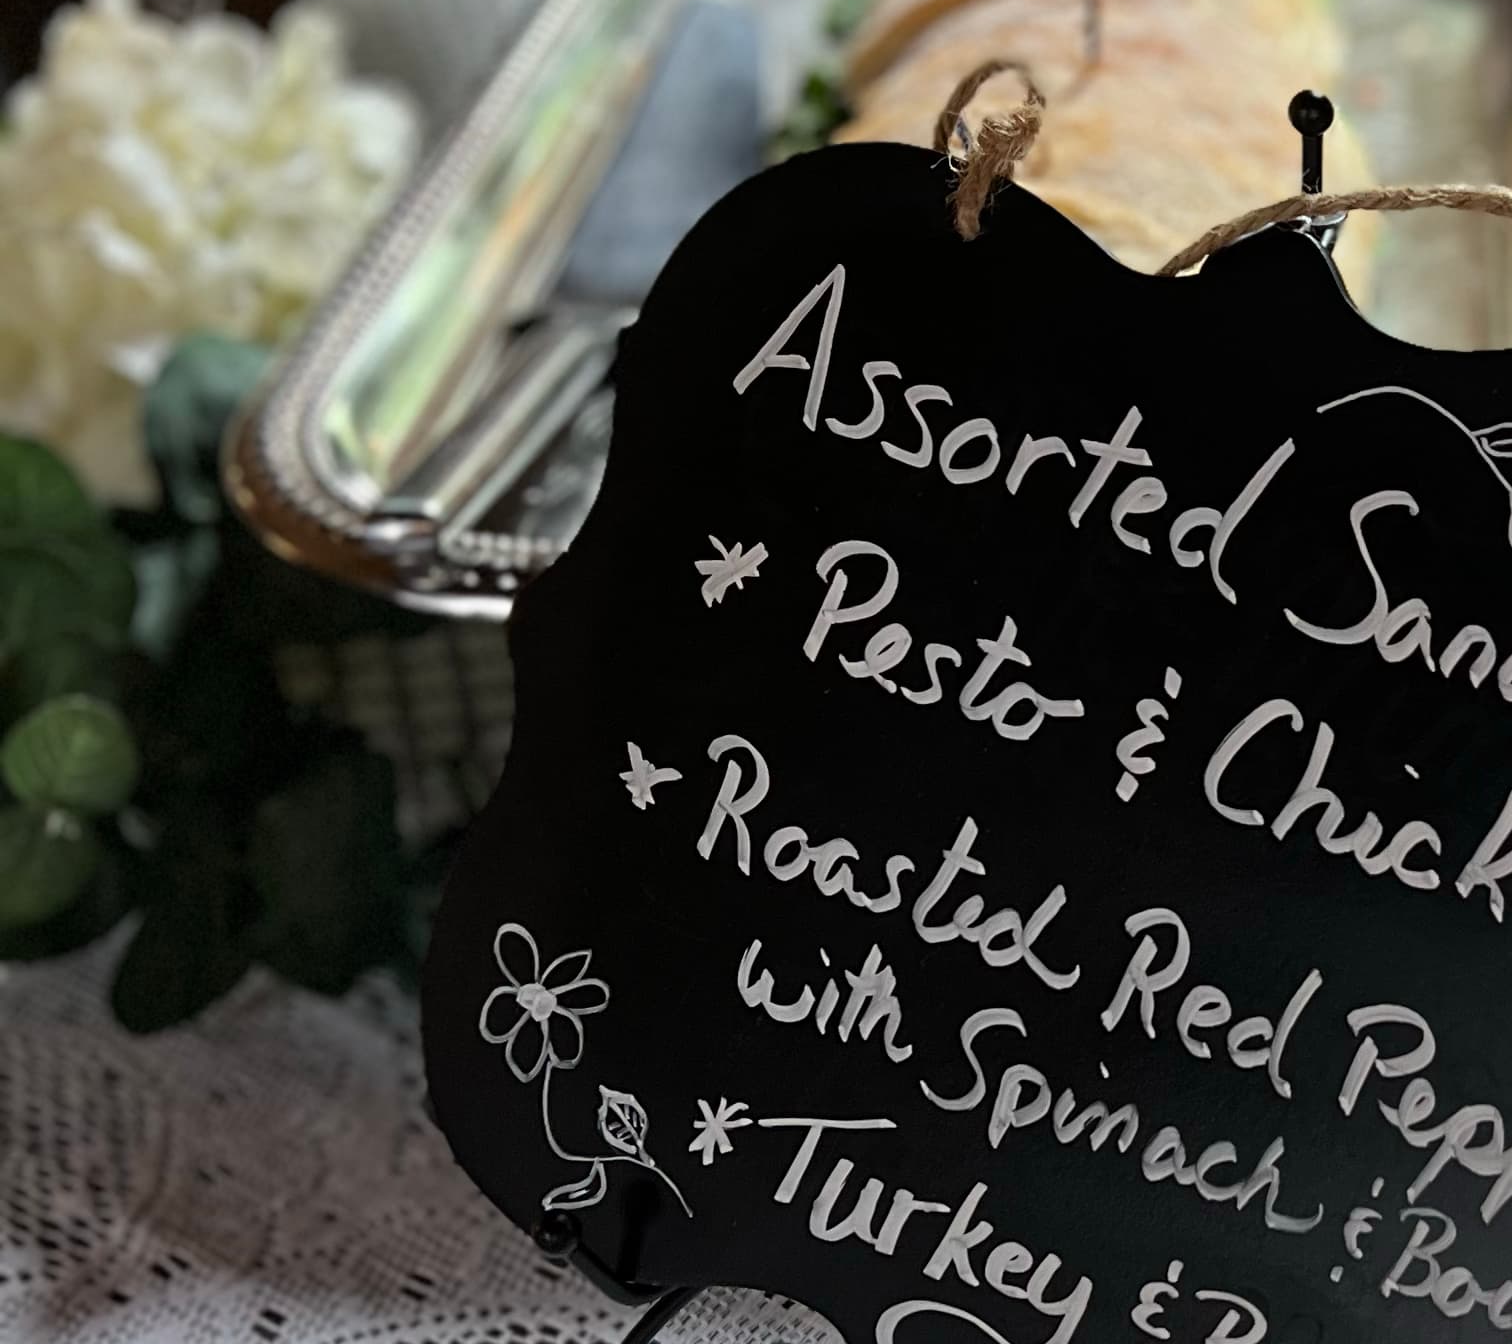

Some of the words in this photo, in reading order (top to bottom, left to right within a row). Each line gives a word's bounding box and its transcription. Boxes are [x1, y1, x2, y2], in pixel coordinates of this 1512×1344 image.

[733, 264, 1296, 606] Assorted
[803, 540, 1085, 742] Pesto
[697, 734, 1080, 991] Roasted
[1101, 908, 1323, 1098] Red
[737, 939, 912, 1062] with
[920, 1008, 1324, 1233] Spinach
